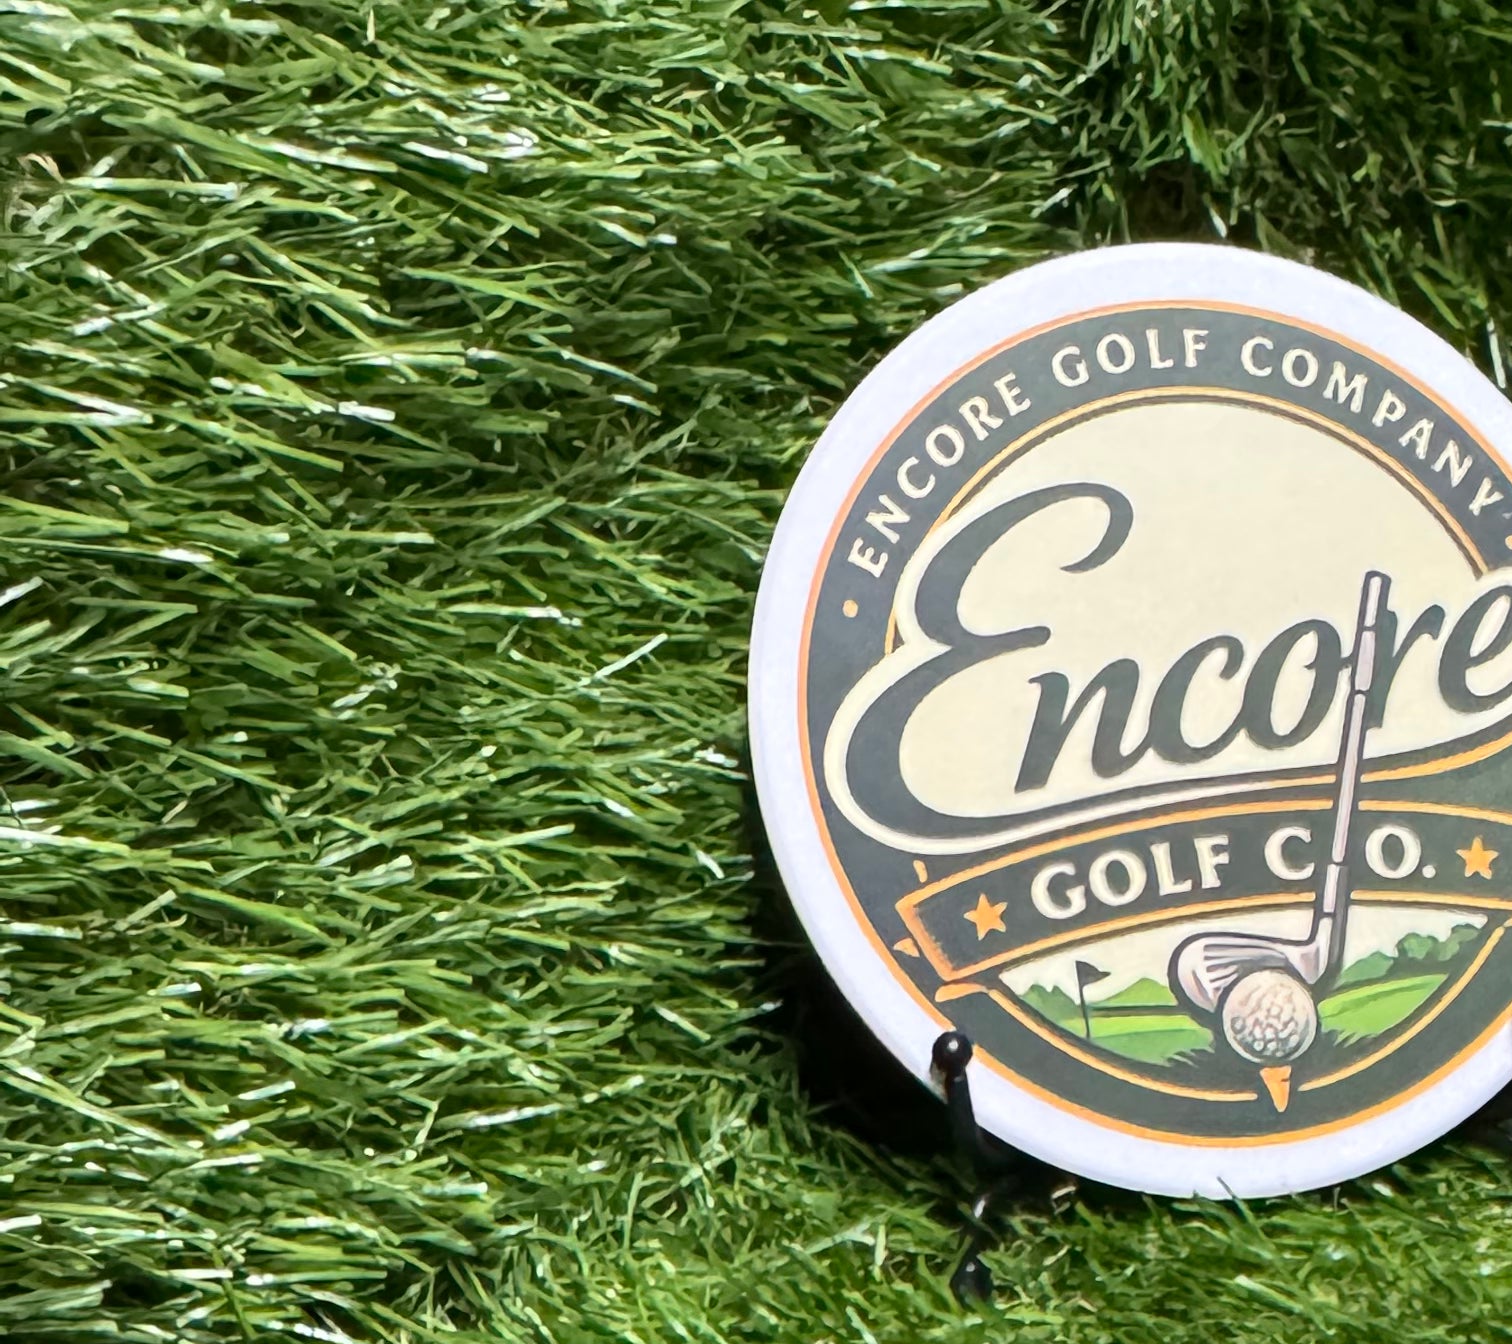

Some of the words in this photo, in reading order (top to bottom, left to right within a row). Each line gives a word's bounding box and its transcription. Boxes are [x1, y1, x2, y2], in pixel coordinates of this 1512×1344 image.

[848, 372, 1031, 578] ENCORE
[1051, 328, 1209, 387] GOLF
[1241, 336, 1504, 517] COMPANY
[1031, 834, 1229, 920] GOLF
